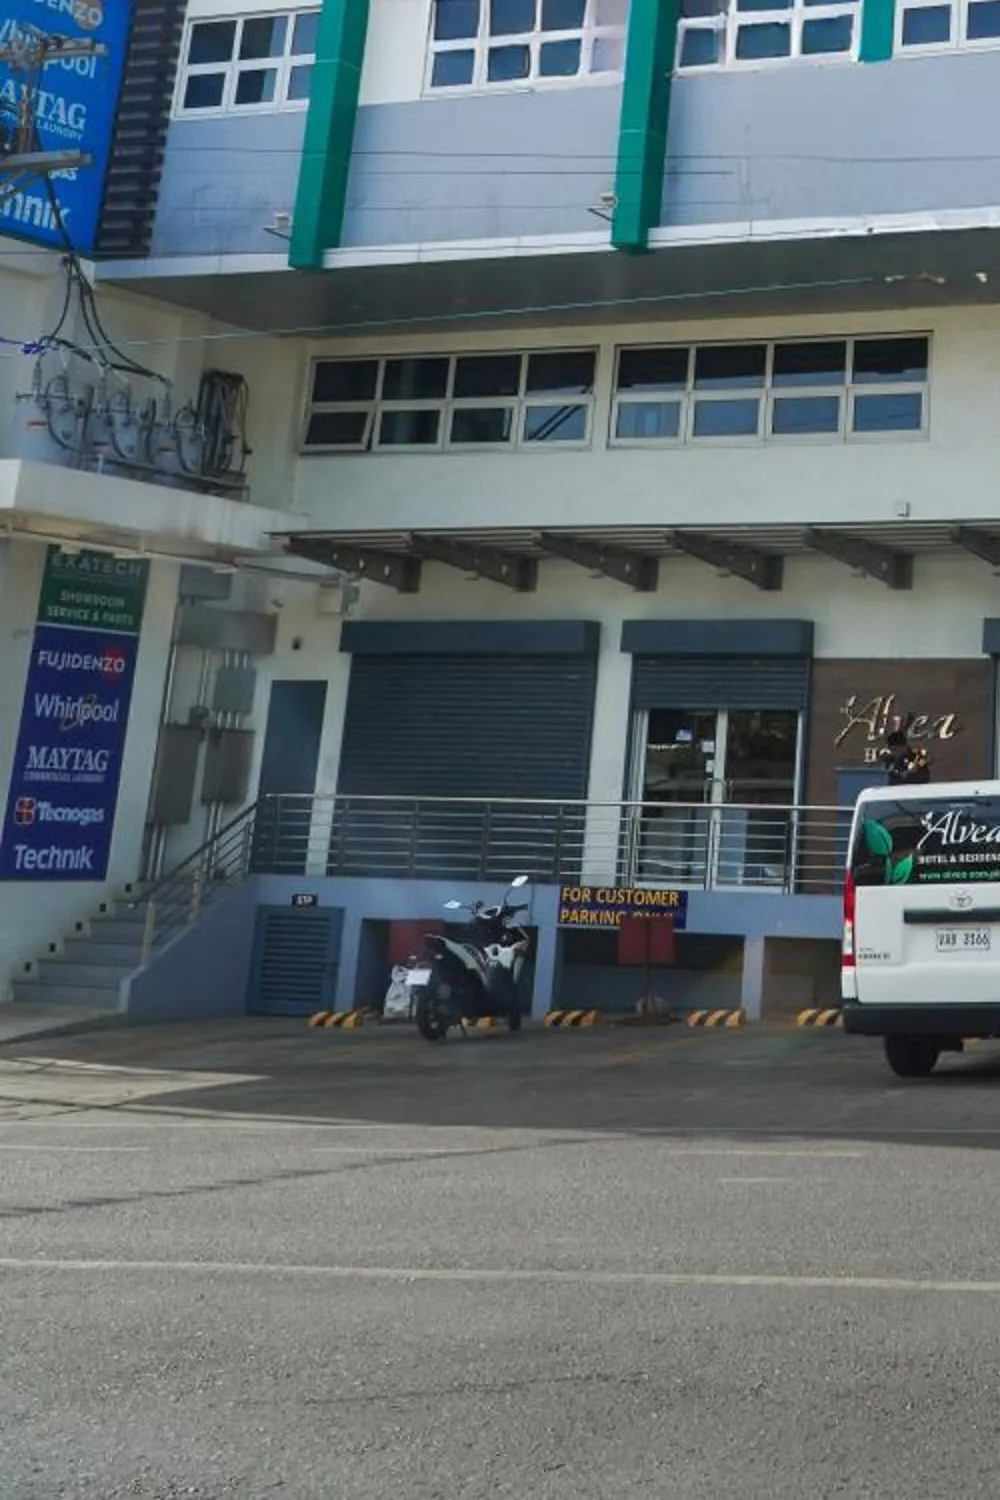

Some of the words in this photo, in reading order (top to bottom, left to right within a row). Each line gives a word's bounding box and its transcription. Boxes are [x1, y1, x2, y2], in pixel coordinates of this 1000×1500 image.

[51, 553, 142, 579] EXATECH
[38, 650, 125, 674] FUJIDENZO
[35, 694, 119, 725] Whirlpool
[834, 693, 960, 749] Alea
[25, 745, 110, 772] MAYTAG
[13, 844, 95, 870] Technik
[562, 887, 591, 903] FOR
[596, 888, 679, 906] CUSTOMER
